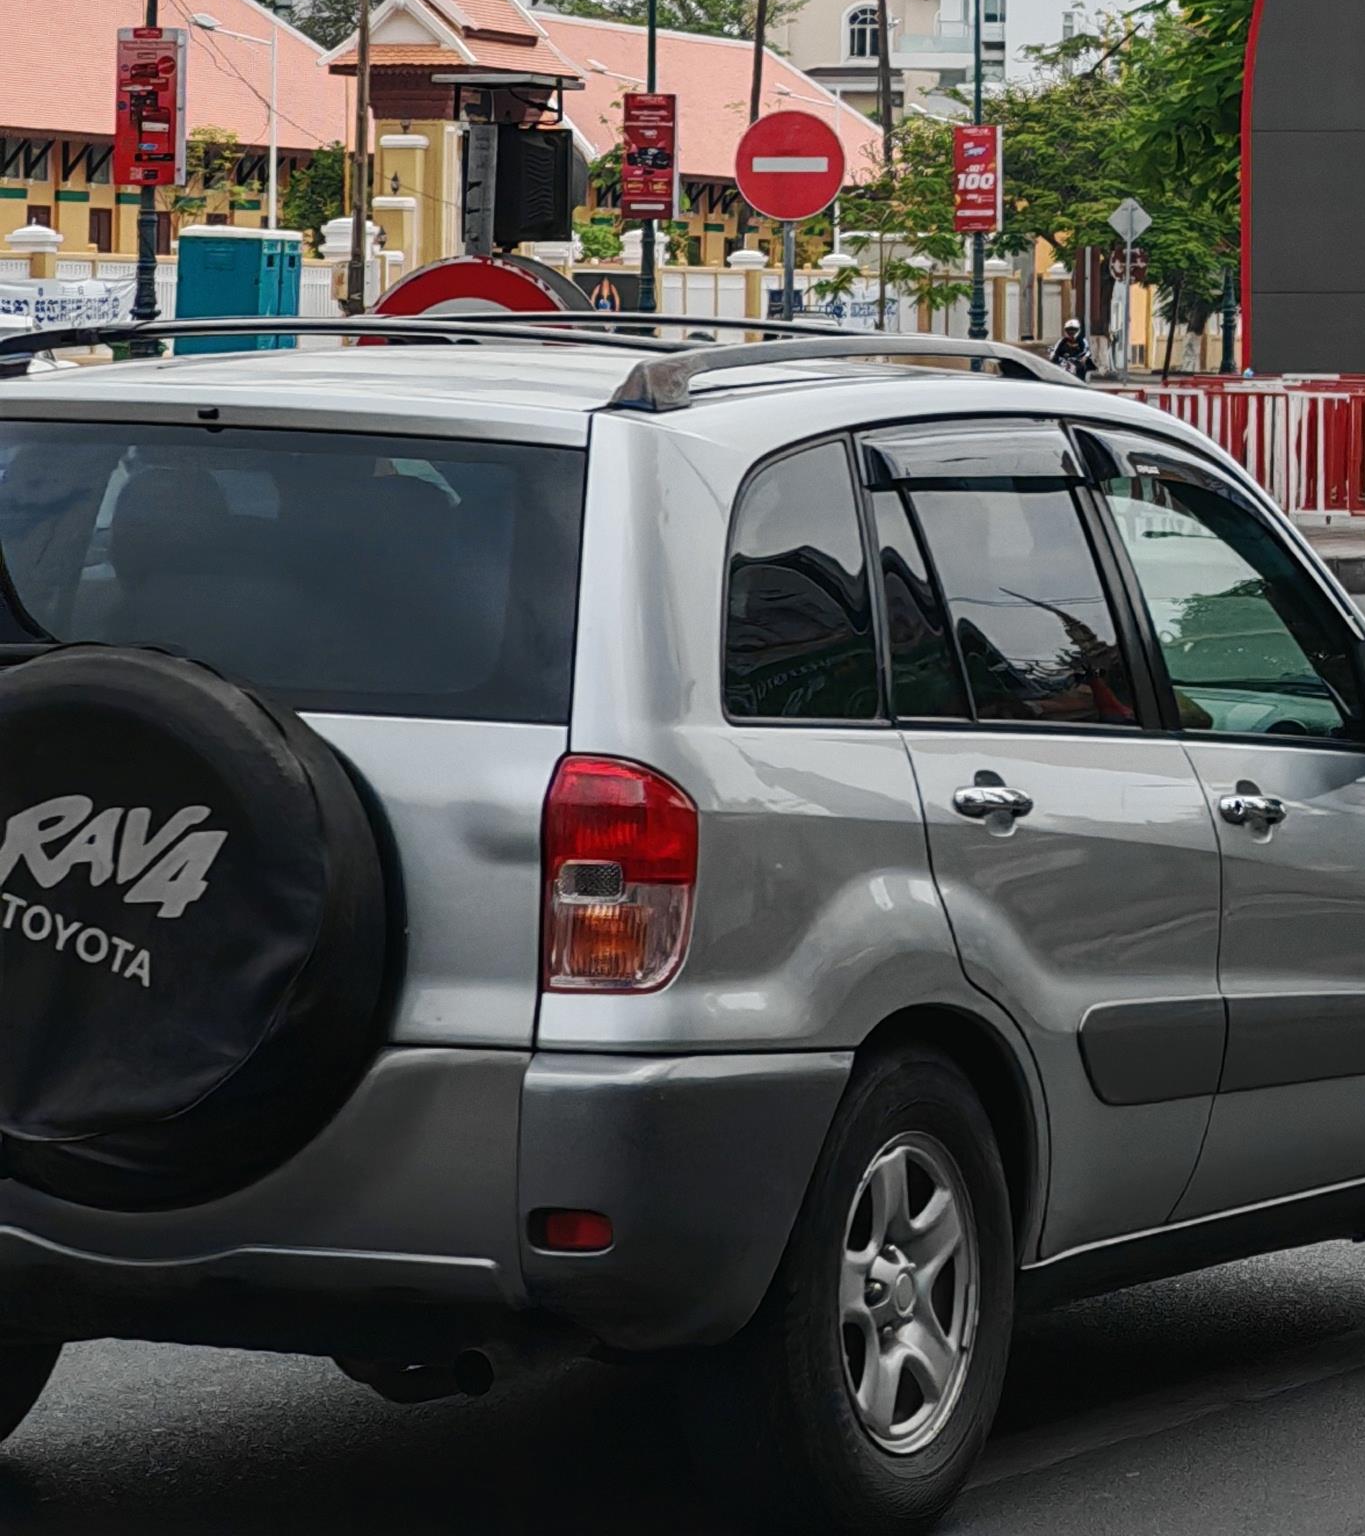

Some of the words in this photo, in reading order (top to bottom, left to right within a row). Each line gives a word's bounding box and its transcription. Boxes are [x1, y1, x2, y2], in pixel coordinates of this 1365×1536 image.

[957, 173, 994, 190] 100
[0, 794, 228, 918] RAV4
[1, 892, 151, 988] TOYOTA
